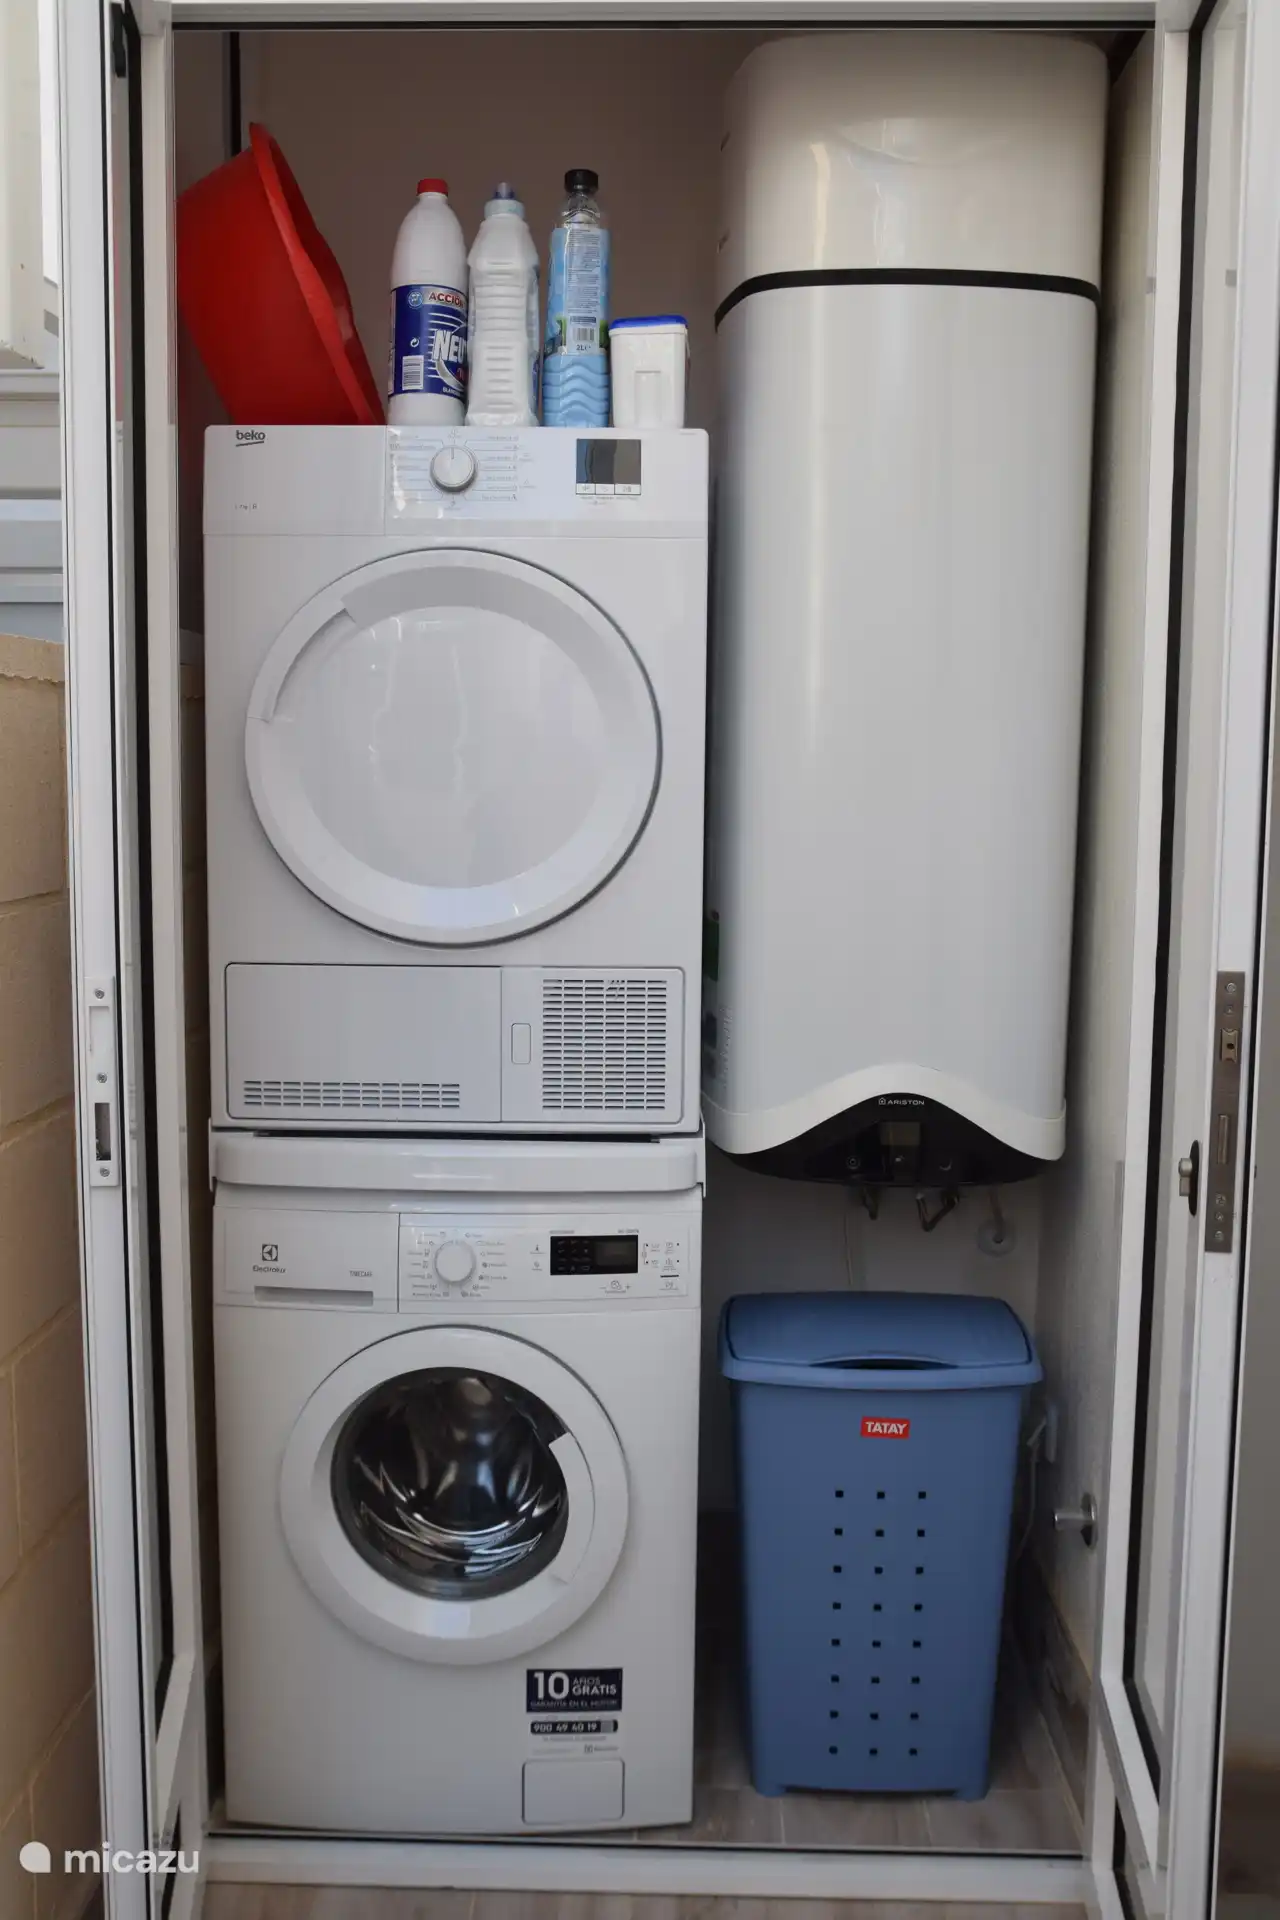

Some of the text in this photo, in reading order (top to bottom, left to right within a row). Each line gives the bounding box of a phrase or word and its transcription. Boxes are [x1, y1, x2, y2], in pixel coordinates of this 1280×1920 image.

[235, 430, 265, 441] beko
[252, 1264, 286, 1274] Electrolux
[864, 1421, 907, 1435] TATAY
[533, 1671, 570, 1700] 10
[571, 1684, 617, 1696] GRATIS
